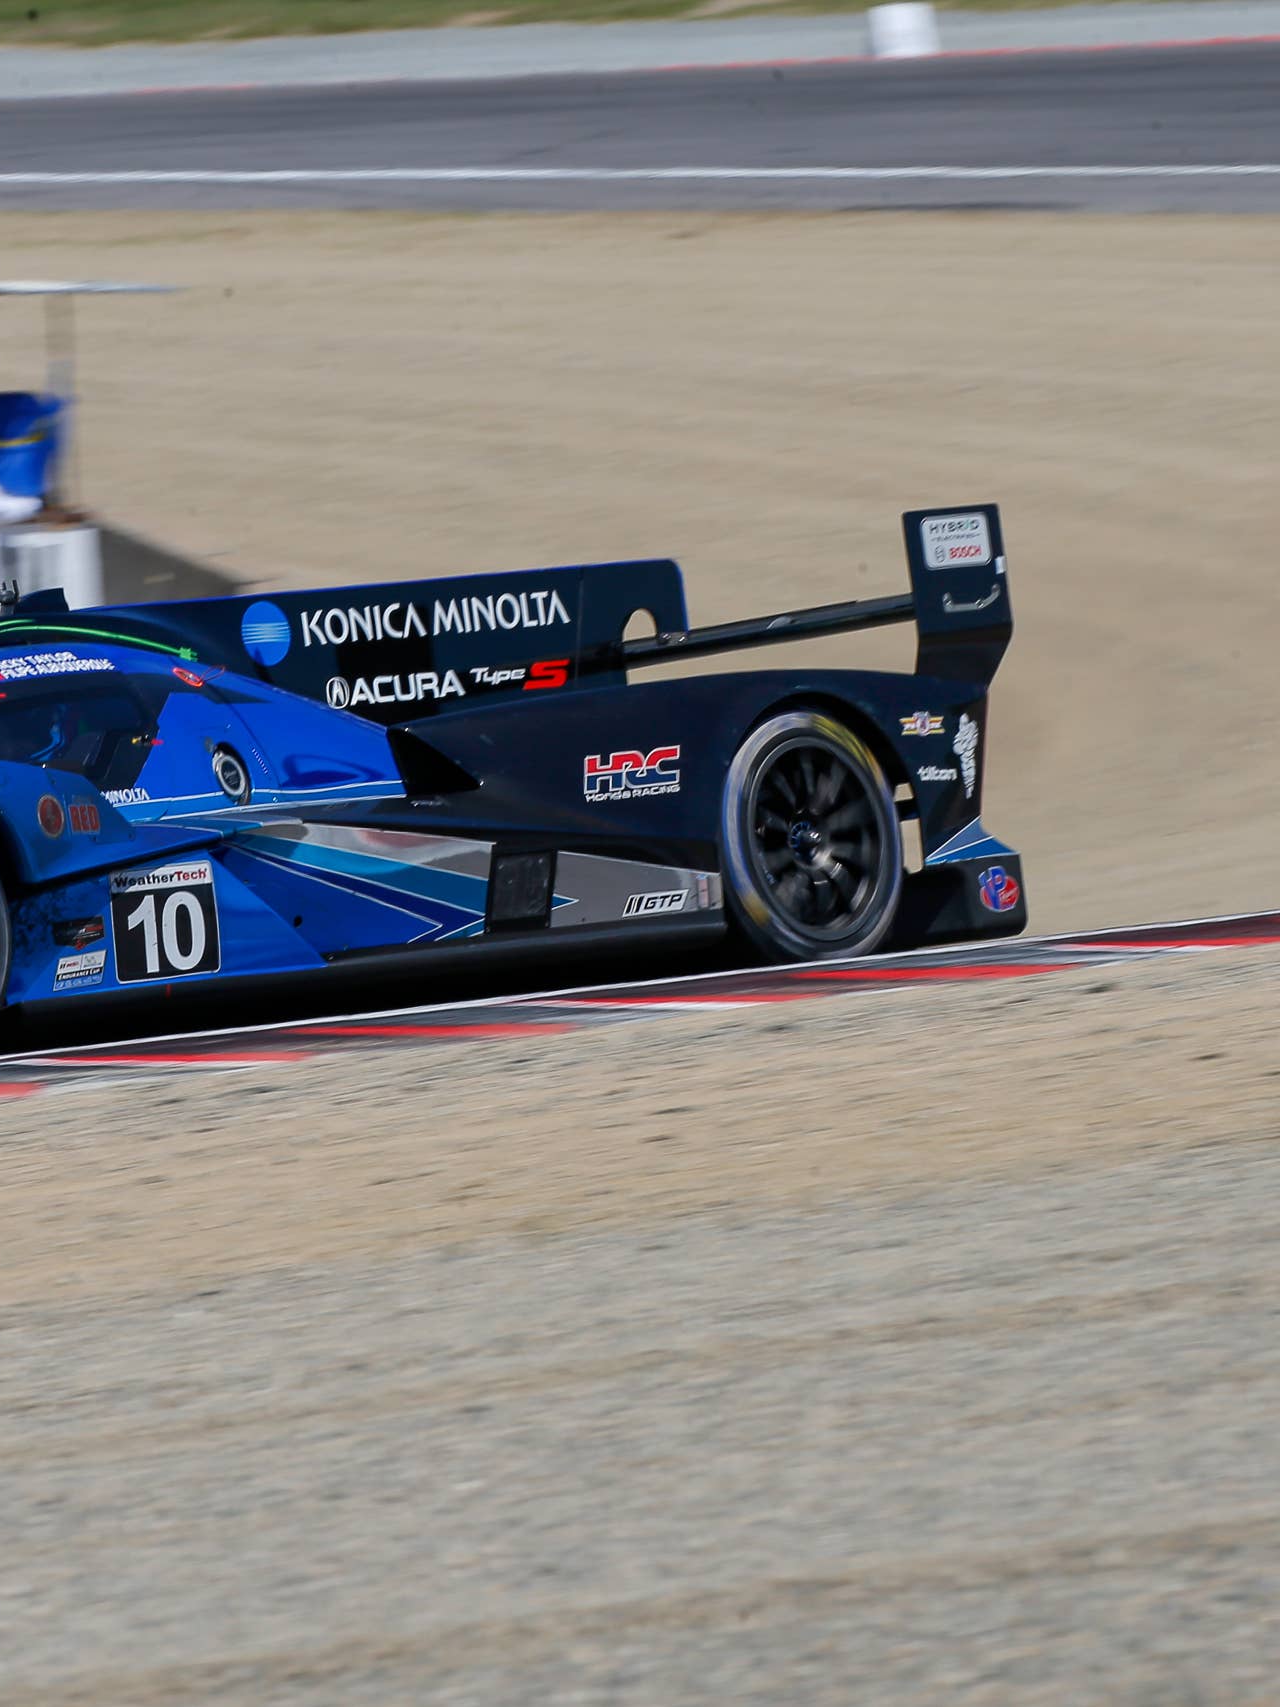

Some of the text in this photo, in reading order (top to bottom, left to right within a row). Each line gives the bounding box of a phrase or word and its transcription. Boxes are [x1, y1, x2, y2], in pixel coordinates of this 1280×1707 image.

[929, 519, 981, 535] HYBRID
[300, 590, 571, 647] KONICA MINOLTA
[349, 659, 569, 706] ACURA Type S
[584, 745, 681, 795] HRC
[632, 783, 681, 798] RACING
[68, 804, 100, 832] RED
[114, 868, 207, 888] WeatherTech
[643, 893, 683, 911] GTP
[127, 890, 206, 973] 10
